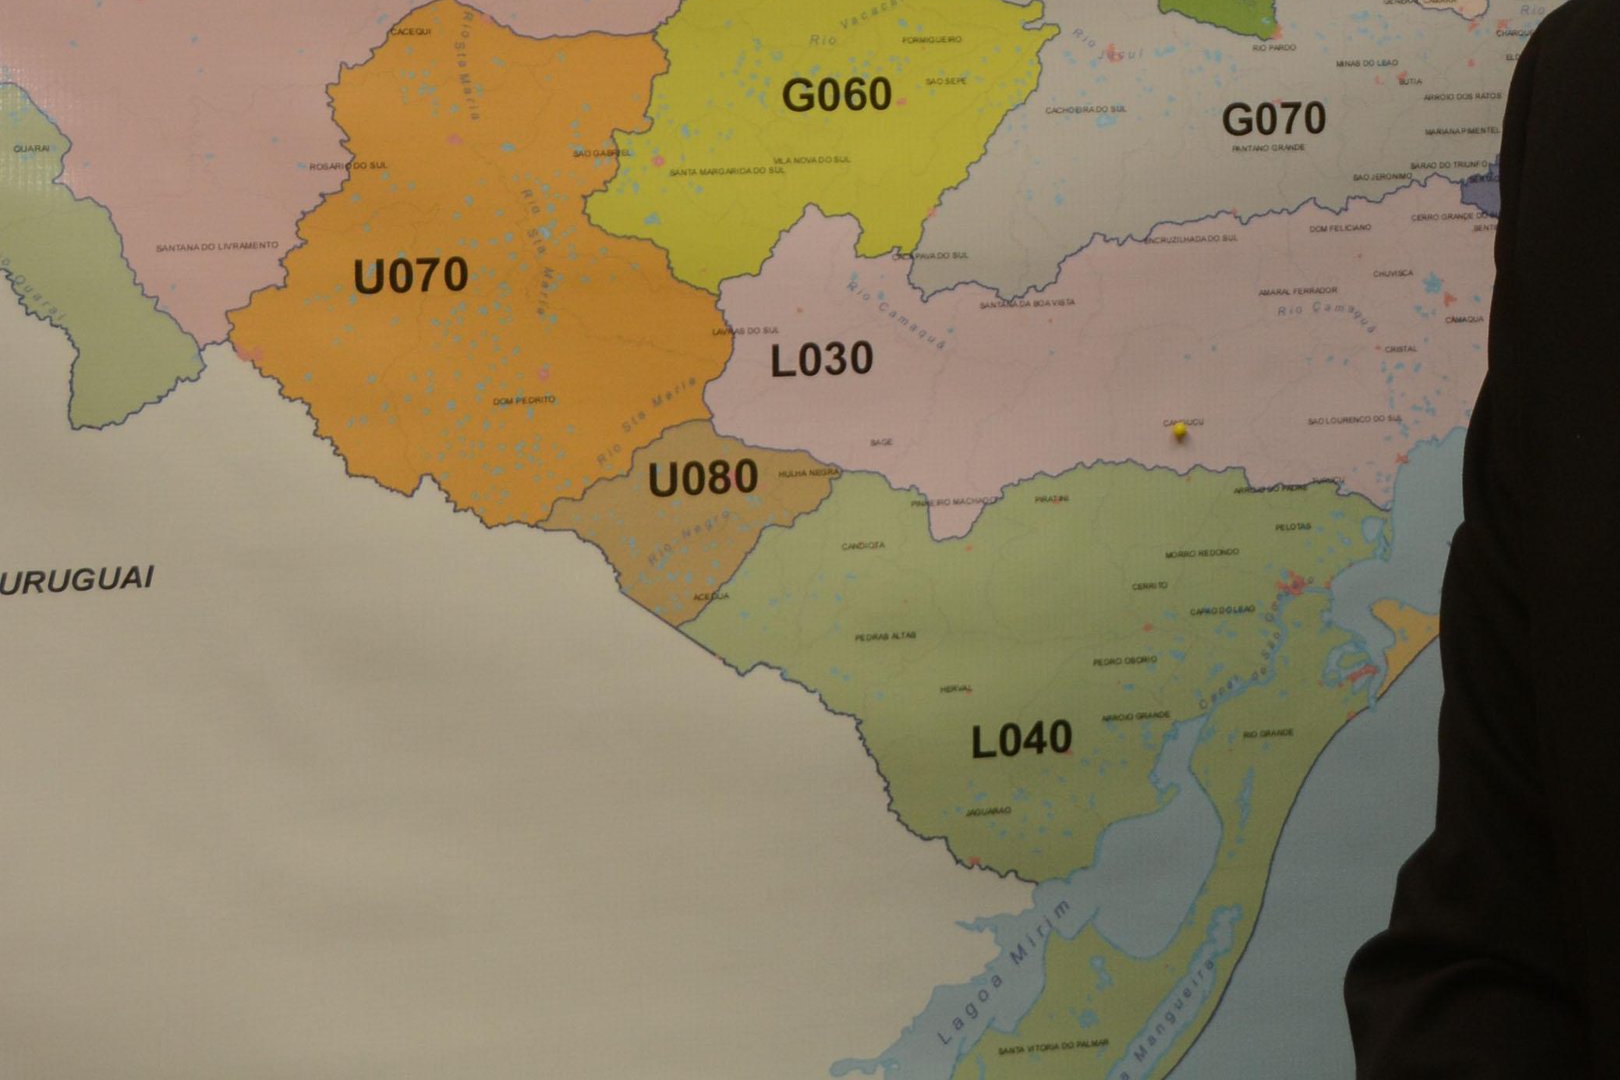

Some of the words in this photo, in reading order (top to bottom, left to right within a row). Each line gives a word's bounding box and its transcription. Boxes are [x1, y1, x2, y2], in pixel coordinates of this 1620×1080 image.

[782, 76, 894, 112] G060
[1222, 100, 1327, 136] G070
[354, 256, 468, 295] U070
[771, 340, 875, 377] L030
[649, 458, 758, 497] U080
[0, 565, 155, 596] URUGUAI
[971, 719, 1073, 759] L040
[935, 973, 1004, 1046] Lagoa
[1008, 898, 1070, 966] Mirim
[1132, 956, 1215, 1063] Mangueira
